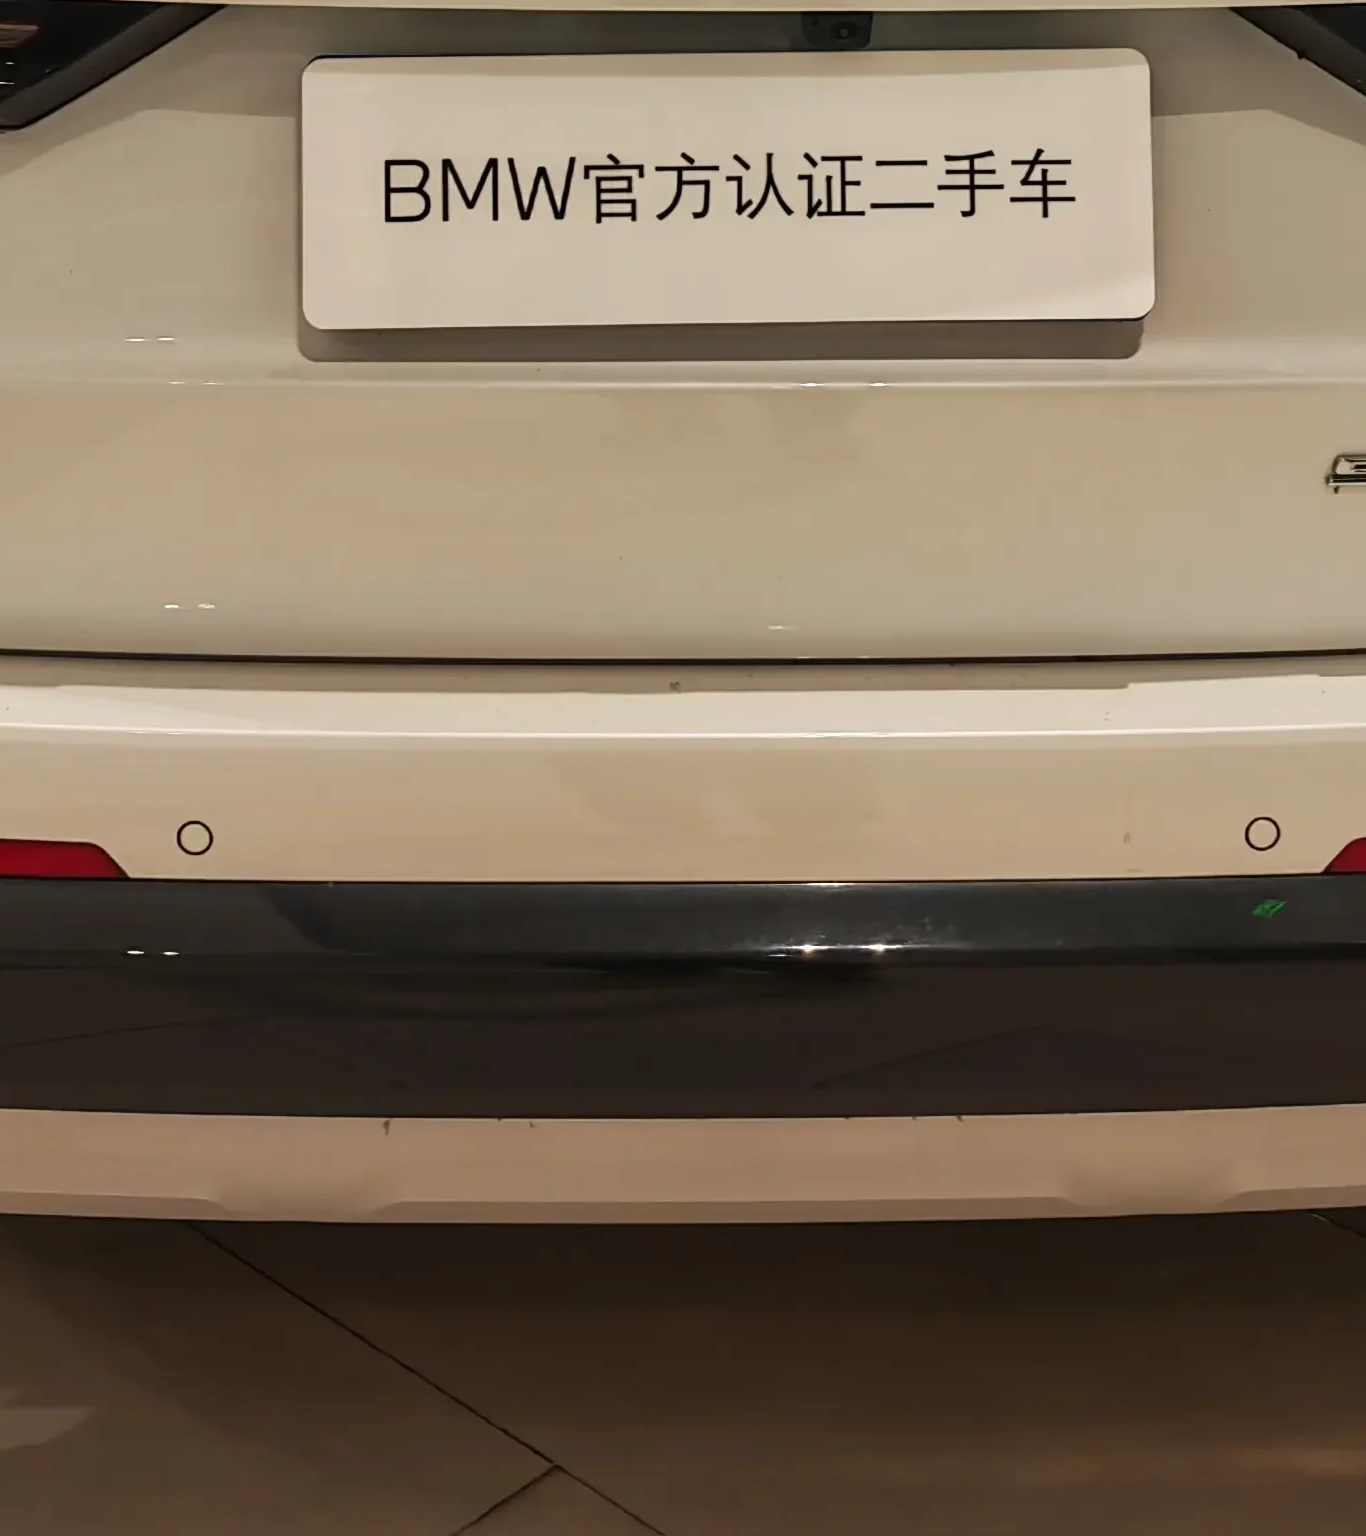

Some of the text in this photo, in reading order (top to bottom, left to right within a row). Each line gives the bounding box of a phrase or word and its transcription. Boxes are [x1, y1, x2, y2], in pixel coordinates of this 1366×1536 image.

[383, 147, 1076, 224] BMW官方认证二手车
